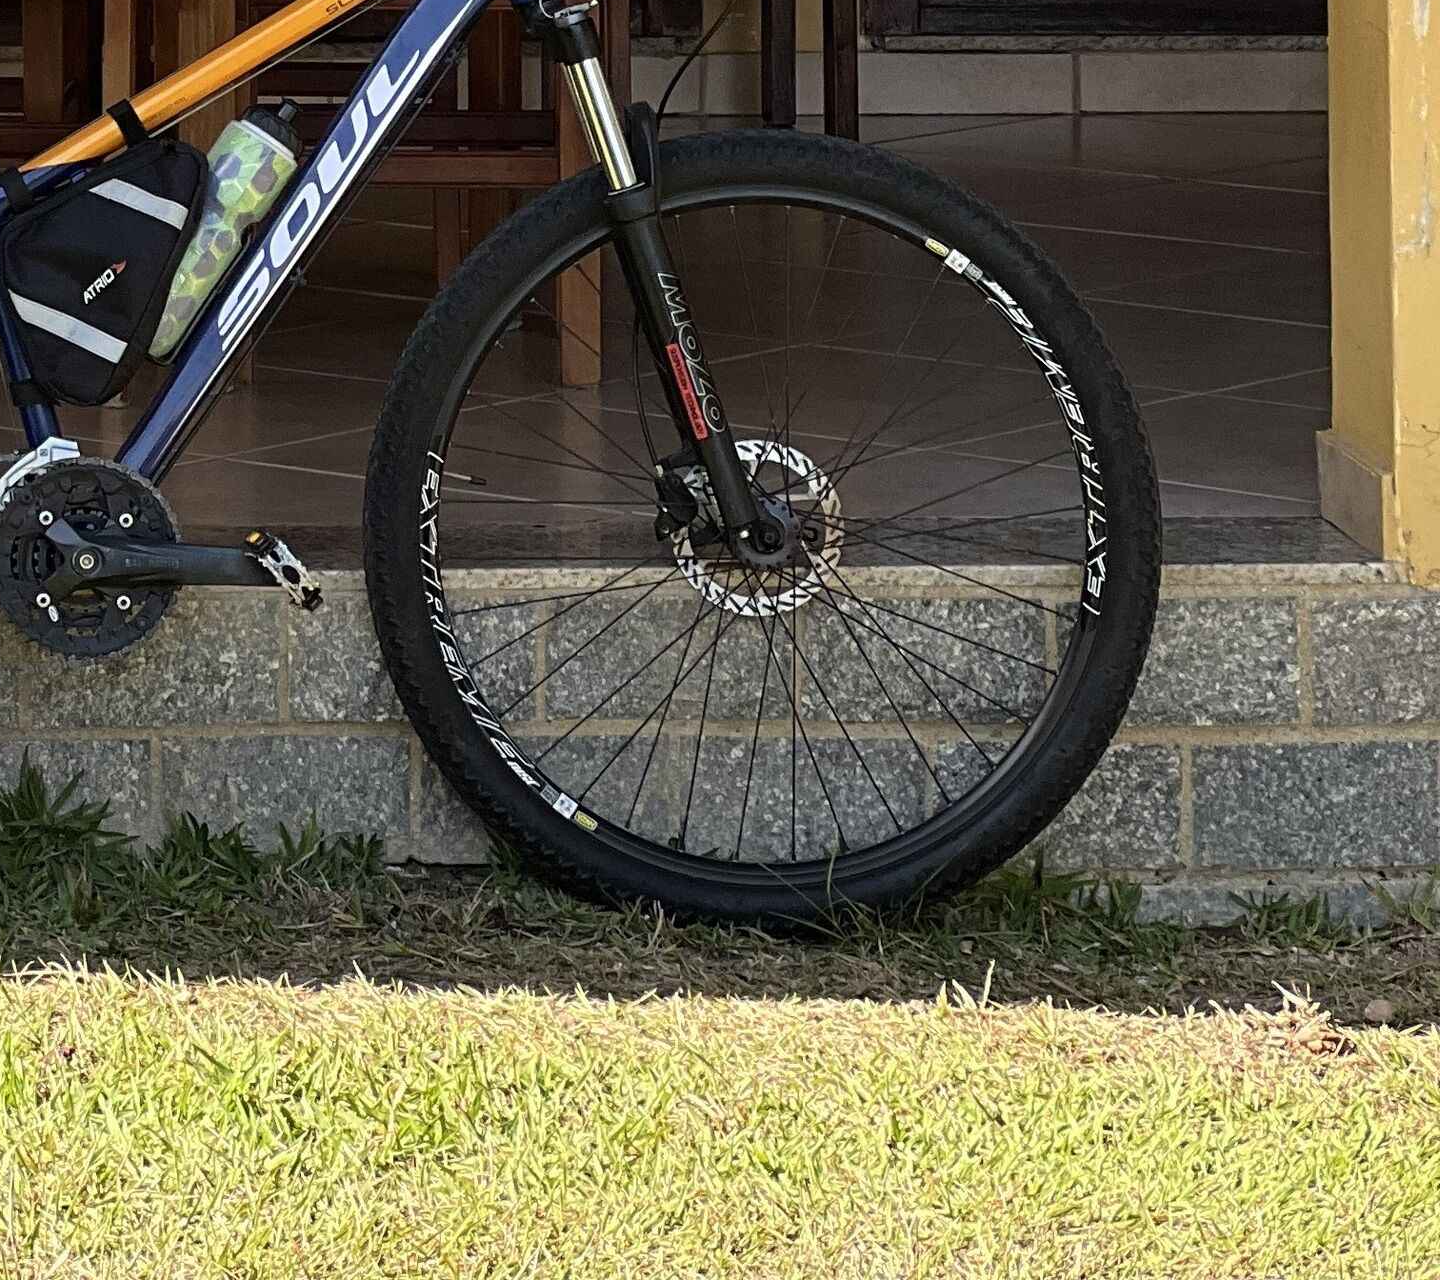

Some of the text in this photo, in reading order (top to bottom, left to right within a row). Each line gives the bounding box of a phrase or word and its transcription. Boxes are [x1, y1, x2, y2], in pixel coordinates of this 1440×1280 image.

[217, 49, 420, 352] SOUL
[83, 268, 115, 305] ATRIO
[657, 272, 727, 433] MOZO
